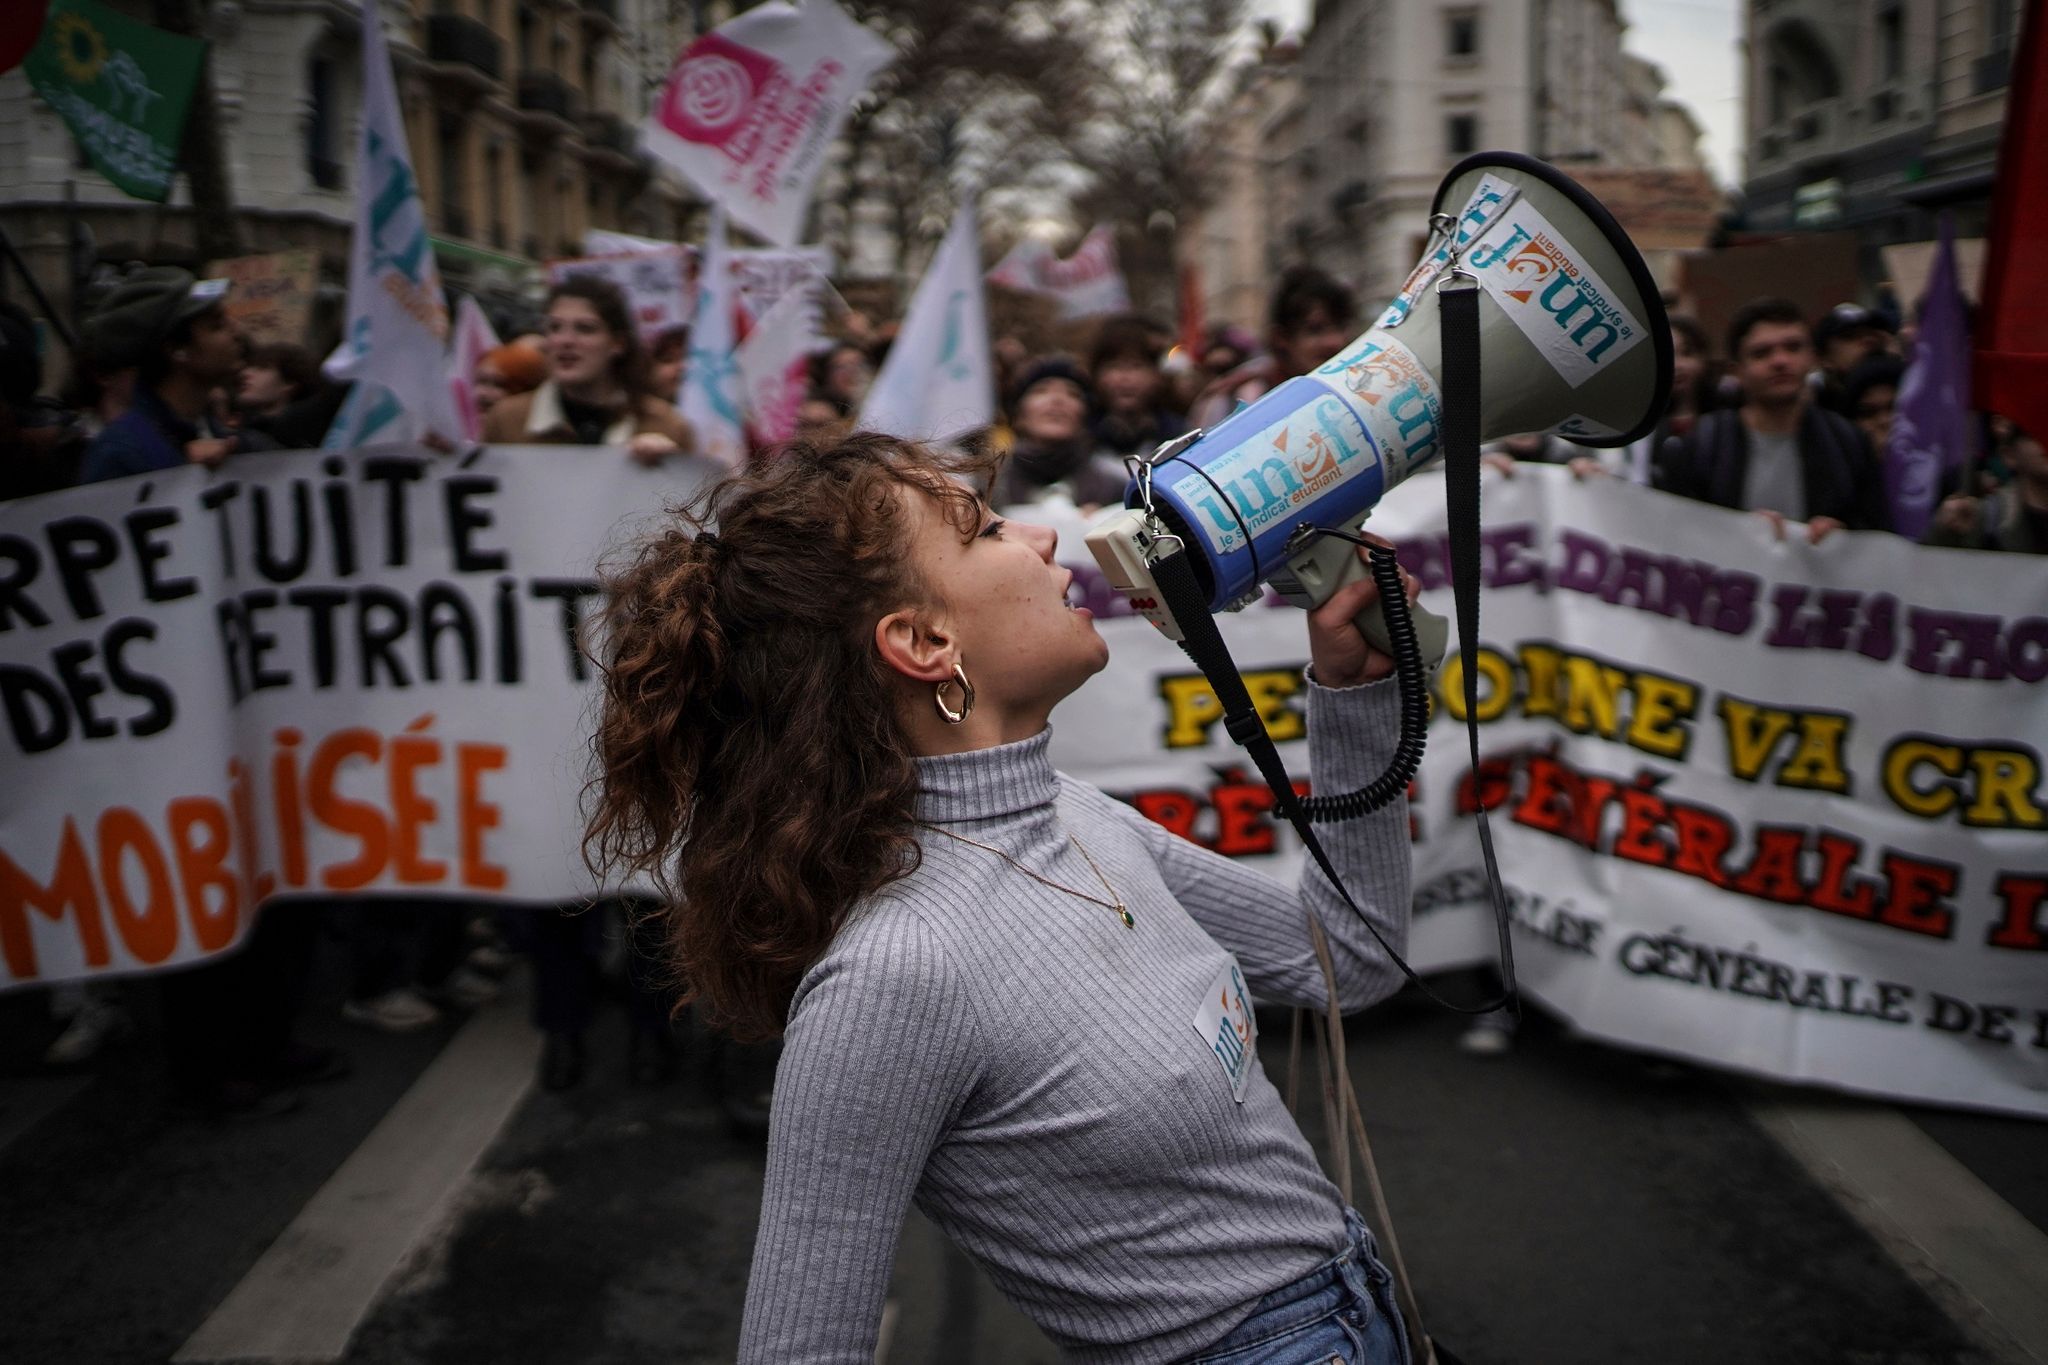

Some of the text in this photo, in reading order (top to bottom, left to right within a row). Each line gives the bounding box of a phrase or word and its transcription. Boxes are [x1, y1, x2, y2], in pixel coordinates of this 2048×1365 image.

[1576, 276, 1624, 329] syndicat
[1619, 325, 1634, 341] le
[1219, 533, 1235, 549] le
[1235, 498, 1292, 541] syndicat
[1553, 525, 1762, 635] DANS
[1764, 581, 1899, 662] LES
[0, 614, 178, 754] DES
[1716, 695, 1854, 795] VA
[1882, 735, 2048, 829] CR
[1619, 924, 1912, 1025] GÉNÉRALE
[1925, 992, 2016, 1049] DE
